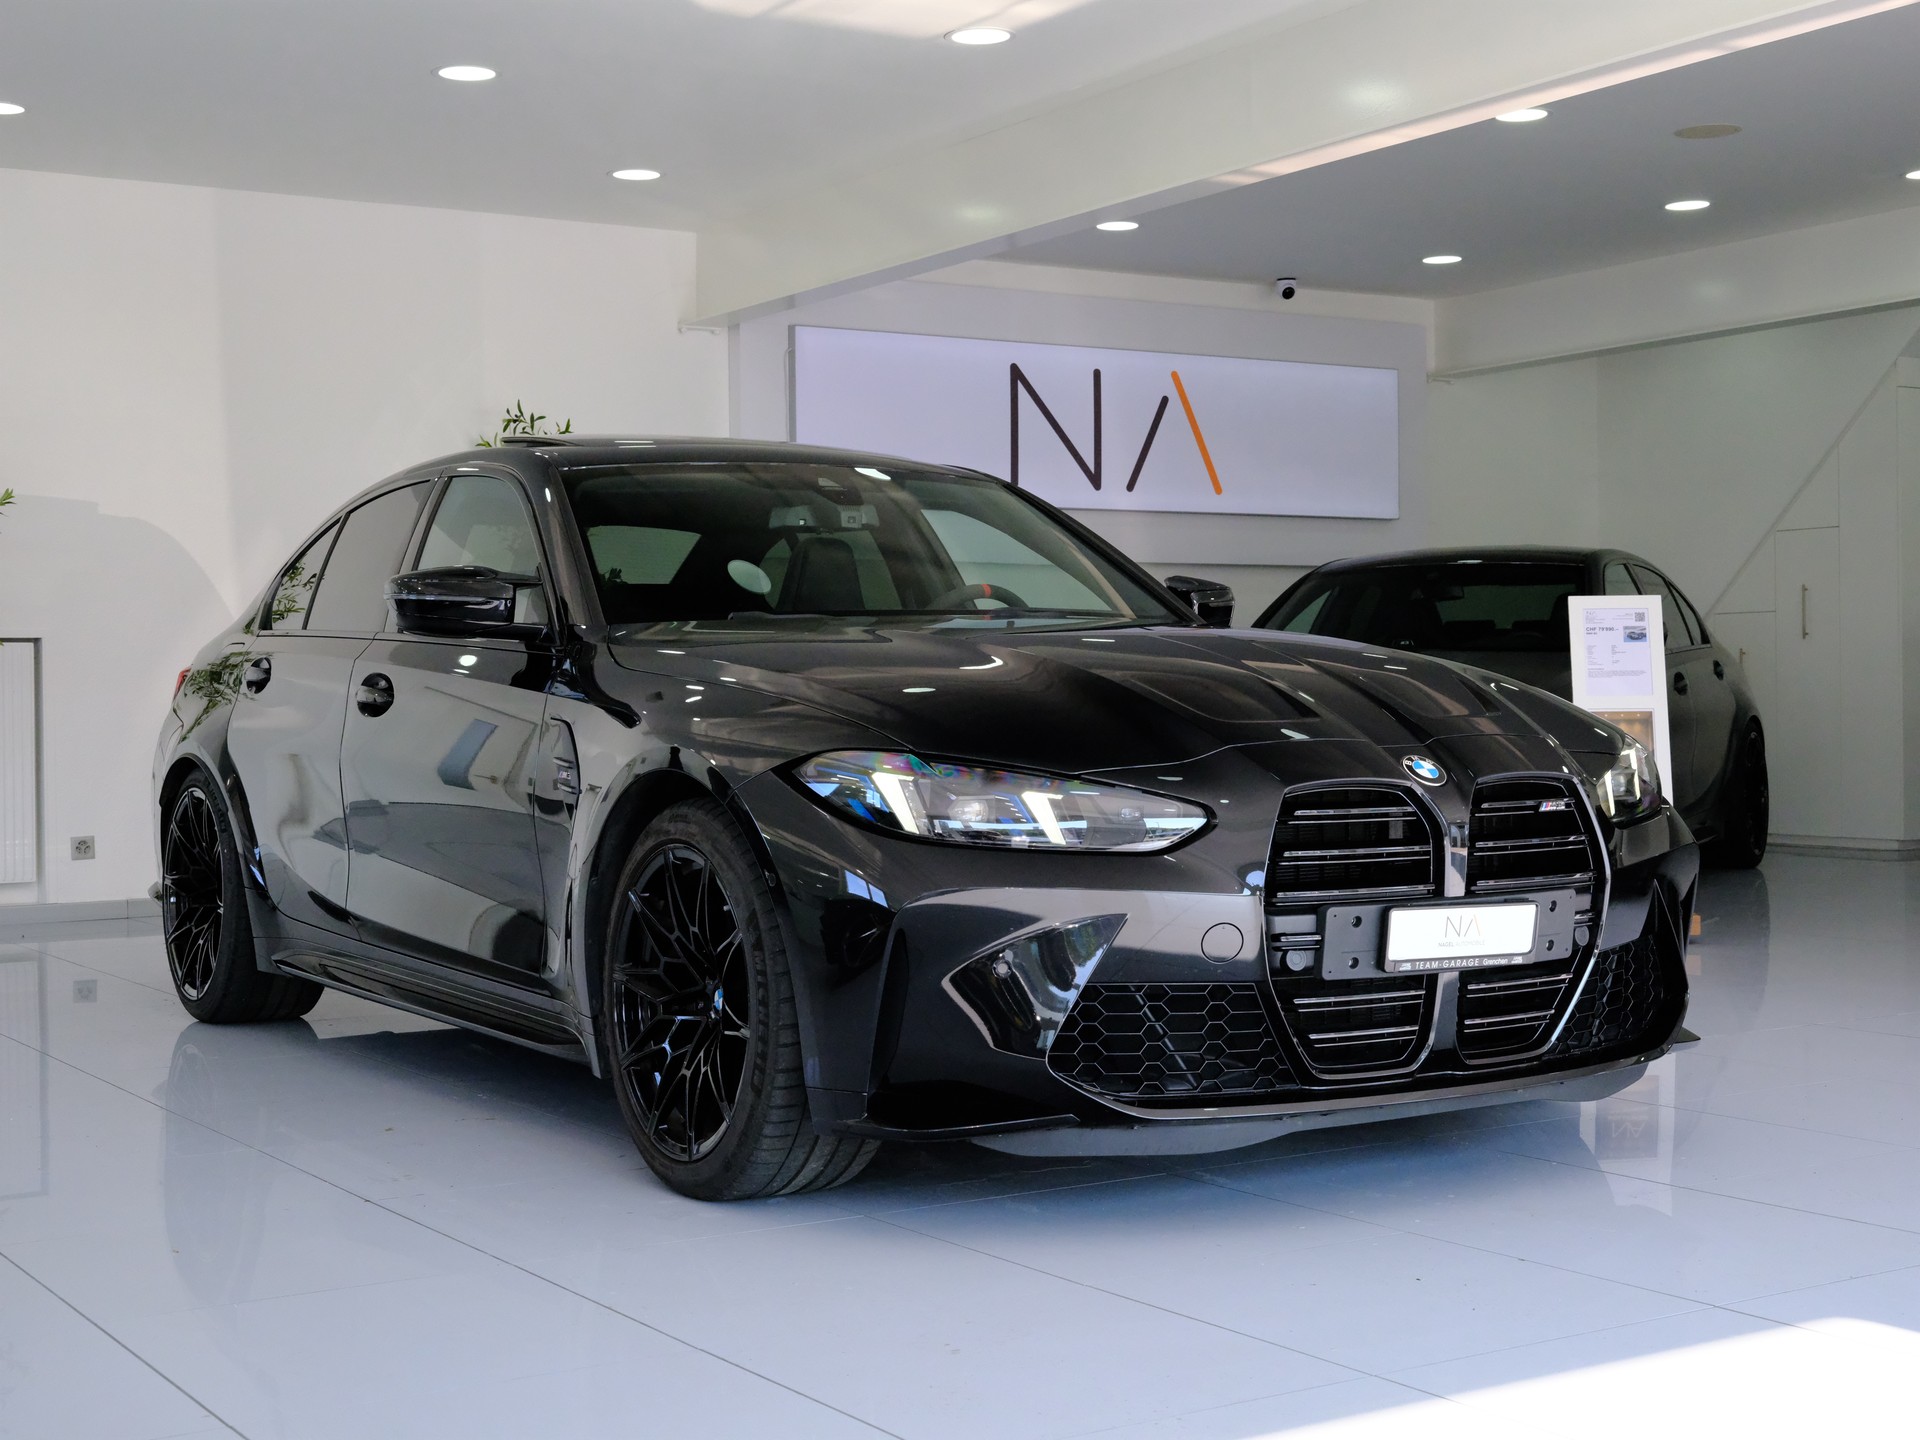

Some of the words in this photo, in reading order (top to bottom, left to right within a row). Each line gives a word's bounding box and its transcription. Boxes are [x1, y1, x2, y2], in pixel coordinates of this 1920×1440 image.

[1010, 363, 1222, 495] NA
[1445, 914, 1480, 938] NA
[1415, 959, 1479, 970] TEAM-GARAGE
[1483, 958, 1508, 966] Grenchen
